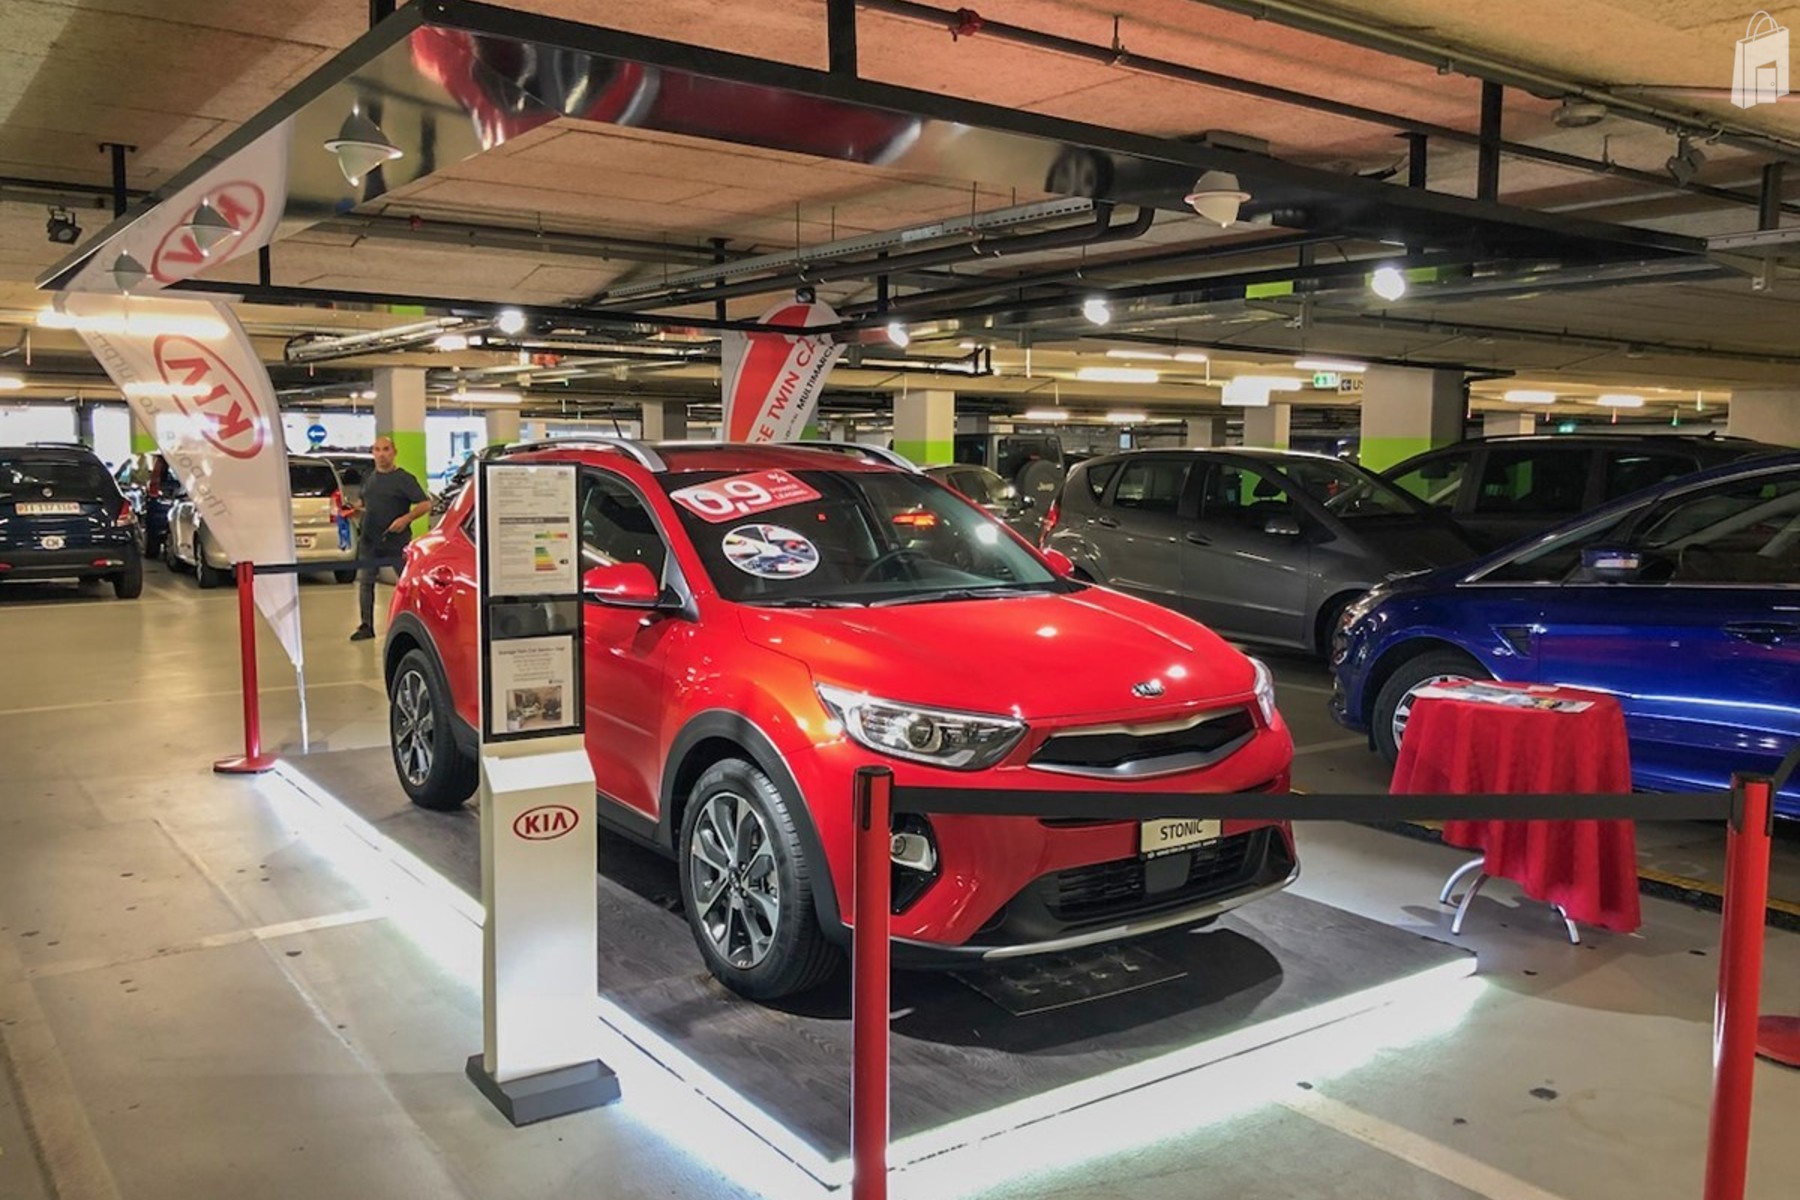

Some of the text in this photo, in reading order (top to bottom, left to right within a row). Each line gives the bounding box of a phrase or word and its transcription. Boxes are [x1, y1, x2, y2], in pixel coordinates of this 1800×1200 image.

[767, 370, 801, 420] TWIN
[525, 811, 568, 834] KIA
[1160, 820, 1204, 841] STONIC
